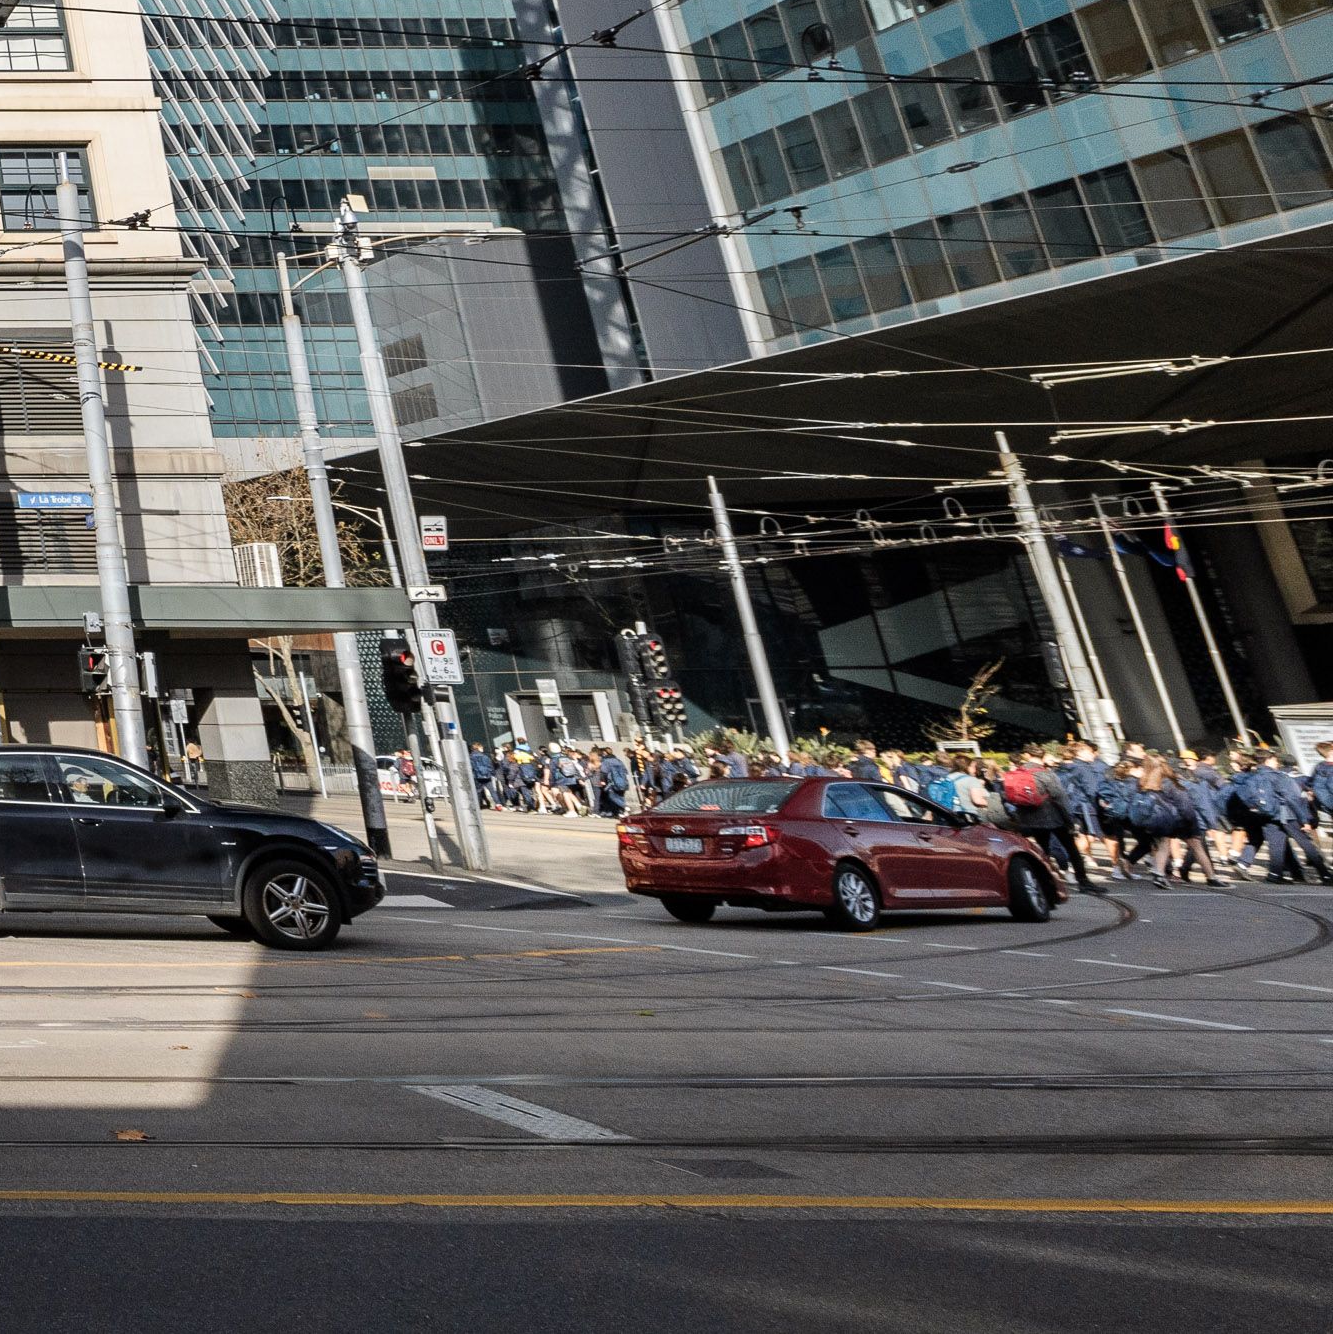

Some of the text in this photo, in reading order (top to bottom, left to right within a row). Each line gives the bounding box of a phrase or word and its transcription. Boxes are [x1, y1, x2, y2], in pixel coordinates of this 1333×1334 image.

[39, 496, 82, 504] La Trobe St
[424, 536, 444, 545] ONLY
